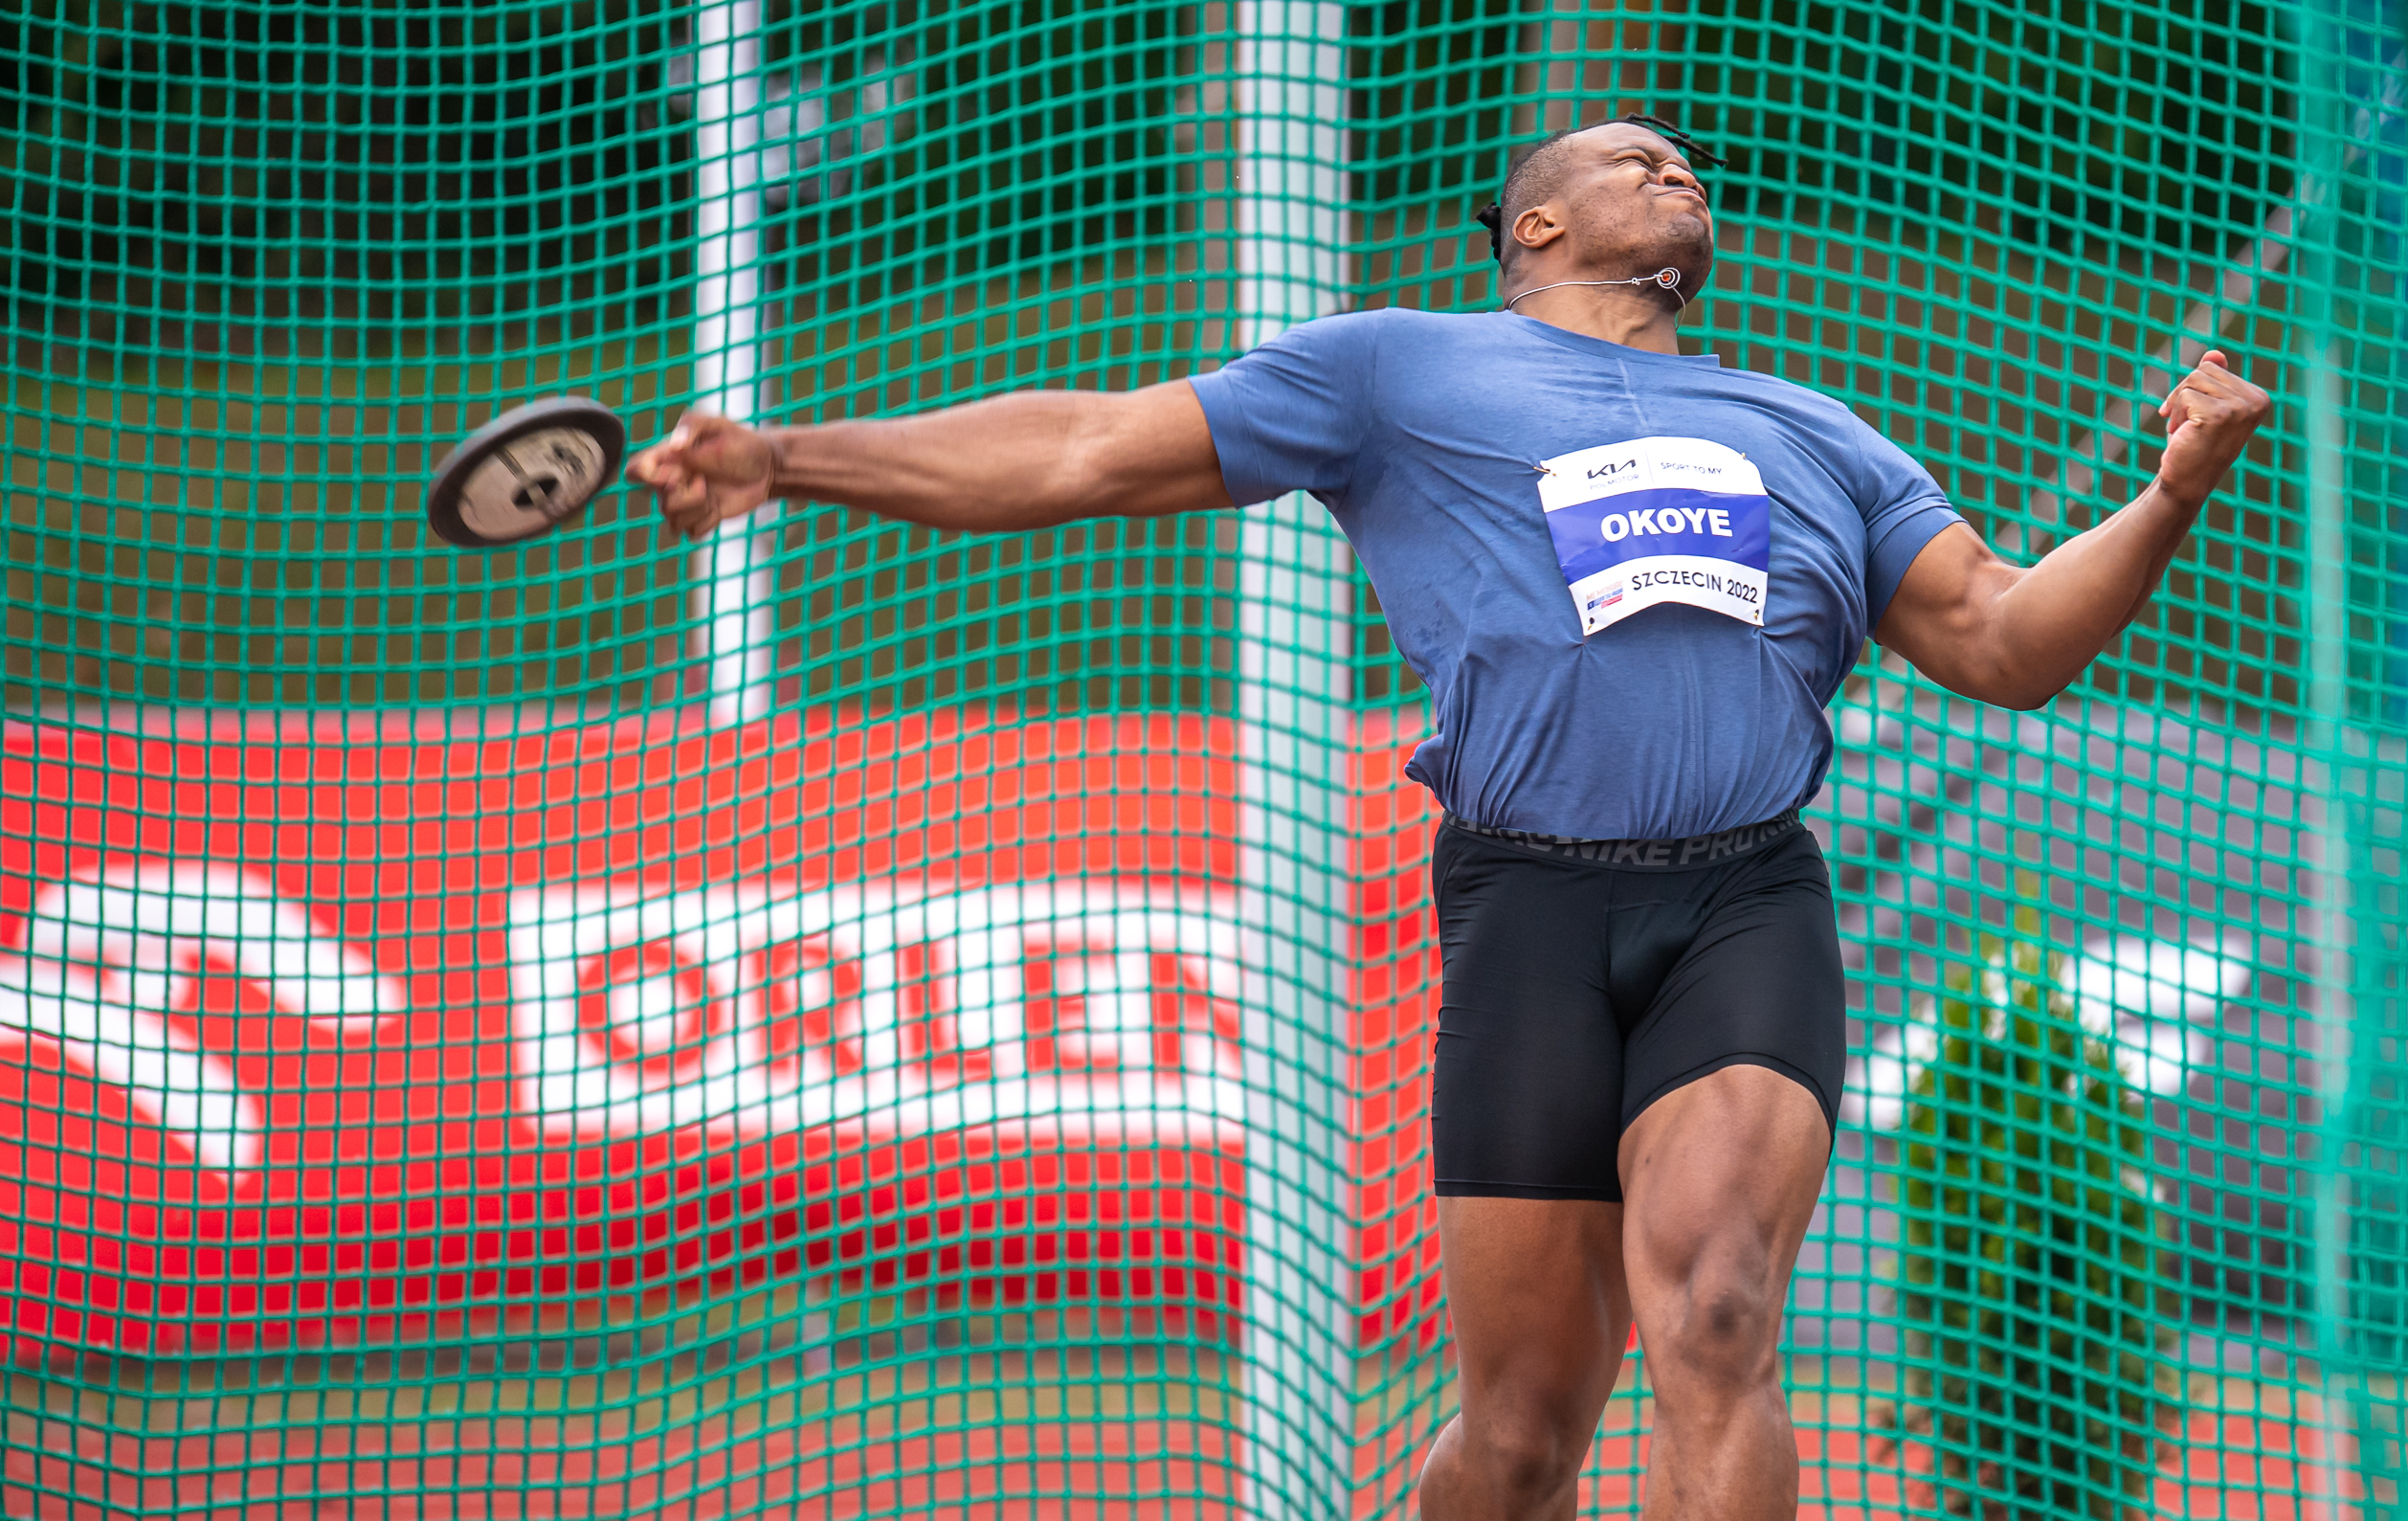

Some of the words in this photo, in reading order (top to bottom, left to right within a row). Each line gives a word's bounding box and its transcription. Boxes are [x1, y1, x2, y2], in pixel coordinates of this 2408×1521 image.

[1590, 473, 1639, 490] POLMOTOR
[1661, 461, 1690, 471] SPORT
[1693, 465, 1706, 475] TO
[1707, 467, 1723, 476] MY
[1600, 507, 1733, 543] OKOYE
[1631, 570, 1723, 593] SZCZECIN
[1726, 579, 1758, 604] 2022
[1560, 836, 1675, 866] NIKE
[1679, 824, 1753, 865] PRO
